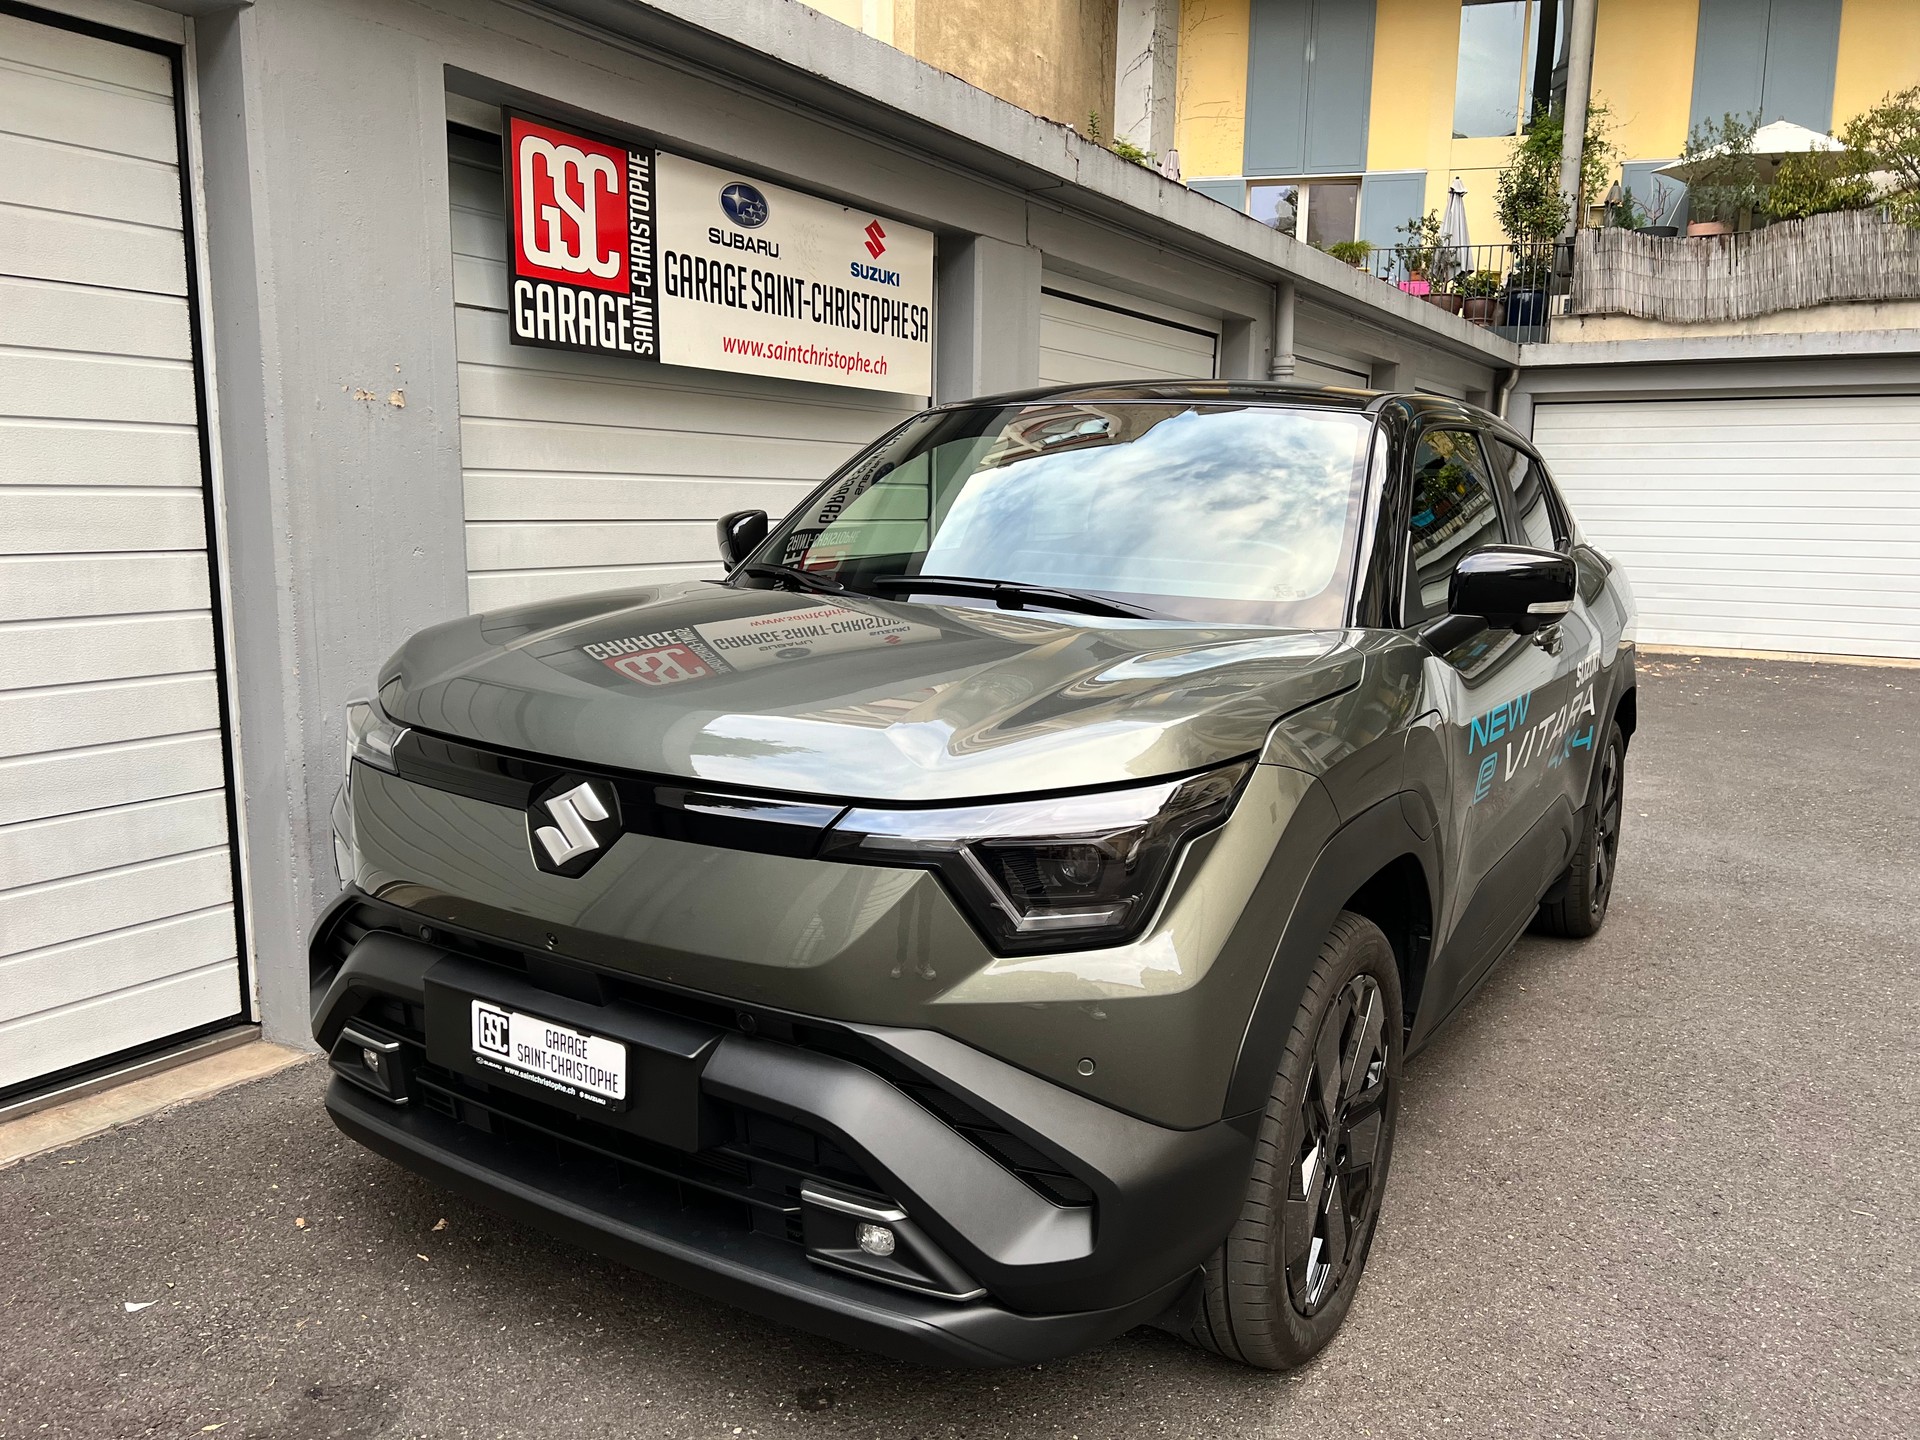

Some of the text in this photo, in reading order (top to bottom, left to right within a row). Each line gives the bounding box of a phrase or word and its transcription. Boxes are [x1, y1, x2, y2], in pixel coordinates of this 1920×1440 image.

[628, 151, 654, 355] SAINT-CHRISTOPHE
[708, 227, 781, 259] SUBARU
[665, 250, 929, 344] GARAGE SAINT-CHRISTOPHE SA
[850, 261, 900, 287] SUZUKI
[514, 279, 632, 352] GARAGE
[722, 336, 888, 376] www.saintchristophe.ch
[1468, 690, 1531, 755] NEW
[1504, 683, 1596, 783] VITARA
[517, 1043, 619, 1094] SAINT-CHRISTOPHE
[545, 1029, 588, 1060] GARAGE
[504, 1066, 576, 1096] www.saintchristophe.ch
